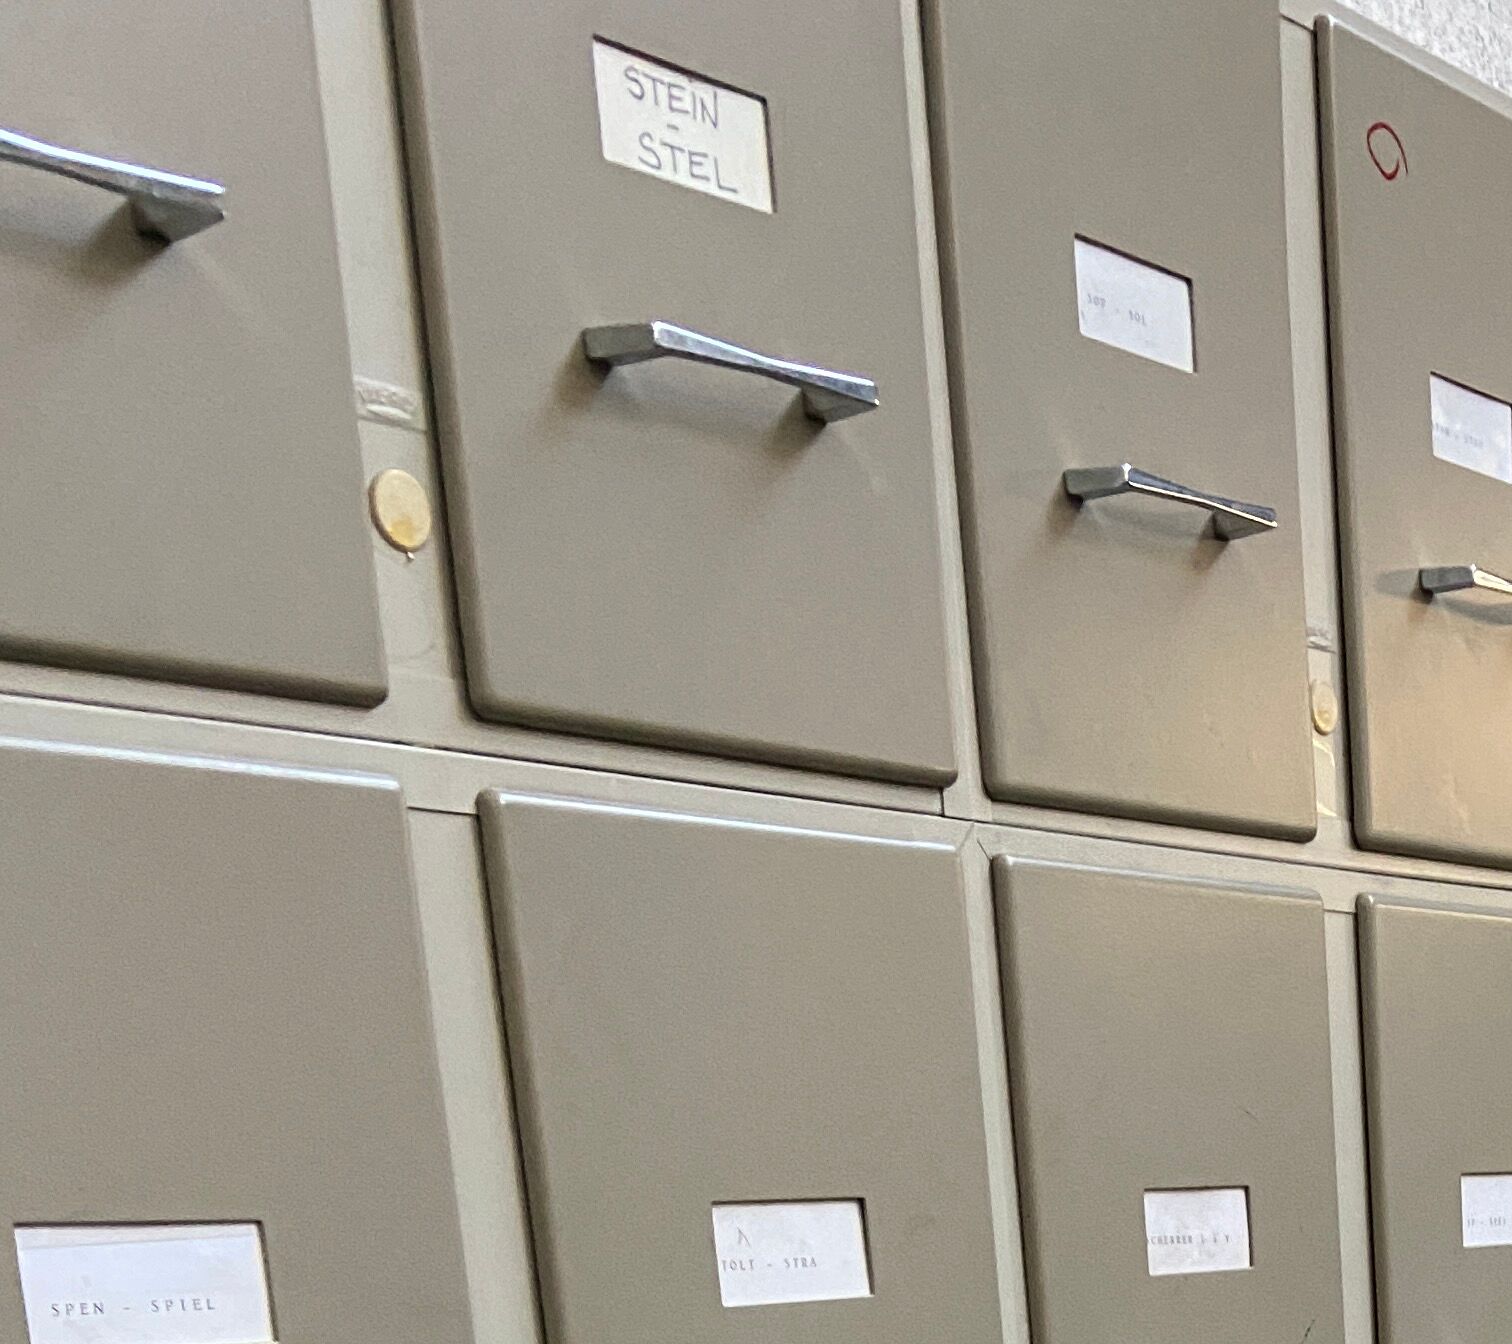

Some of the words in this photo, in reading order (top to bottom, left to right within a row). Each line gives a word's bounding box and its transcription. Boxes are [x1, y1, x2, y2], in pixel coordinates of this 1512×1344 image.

[624, 65, 718, 129] STEIN
[638, 132, 738, 194] STEL
[1149, 1236, 1192, 1245] CHERRER
[785, 1257, 817, 1270] STRA
[52, 1301, 105, 1316] SPEN
[152, 1299, 217, 1315] SPIEL
